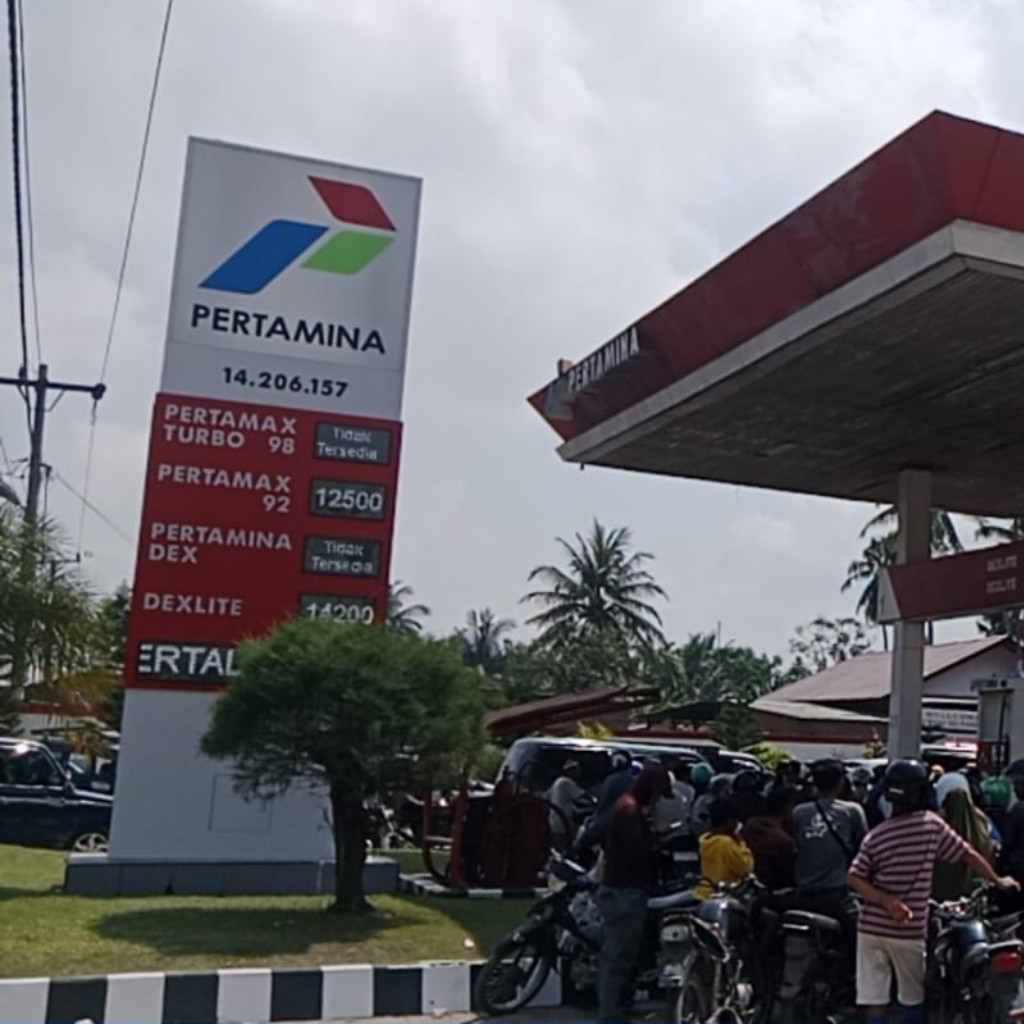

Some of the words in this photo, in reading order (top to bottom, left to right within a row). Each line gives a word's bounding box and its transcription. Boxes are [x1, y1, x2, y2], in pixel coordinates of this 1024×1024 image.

[190, 303, 387, 354] PERTAMINA
[568, 326, 640, 392] PERTAMINA
[221, 366, 349, 398] 14.206.157
[163, 404, 298, 434] PERTAMAX
[163, 424, 246, 449] TURBO
[268, 437, 296, 455] 98
[316, 442, 379, 461] Tersedia
[157, 463, 292, 493] PERTAMAX
[262, 494, 291, 513] 92
[315, 487, 384, 513] 12500
[150, 522, 292, 550] PERTAMINA
[147, 544, 198, 564] DEX
[142, 593, 244, 616] DEXLITE
[305, 602, 375, 626] 14200
